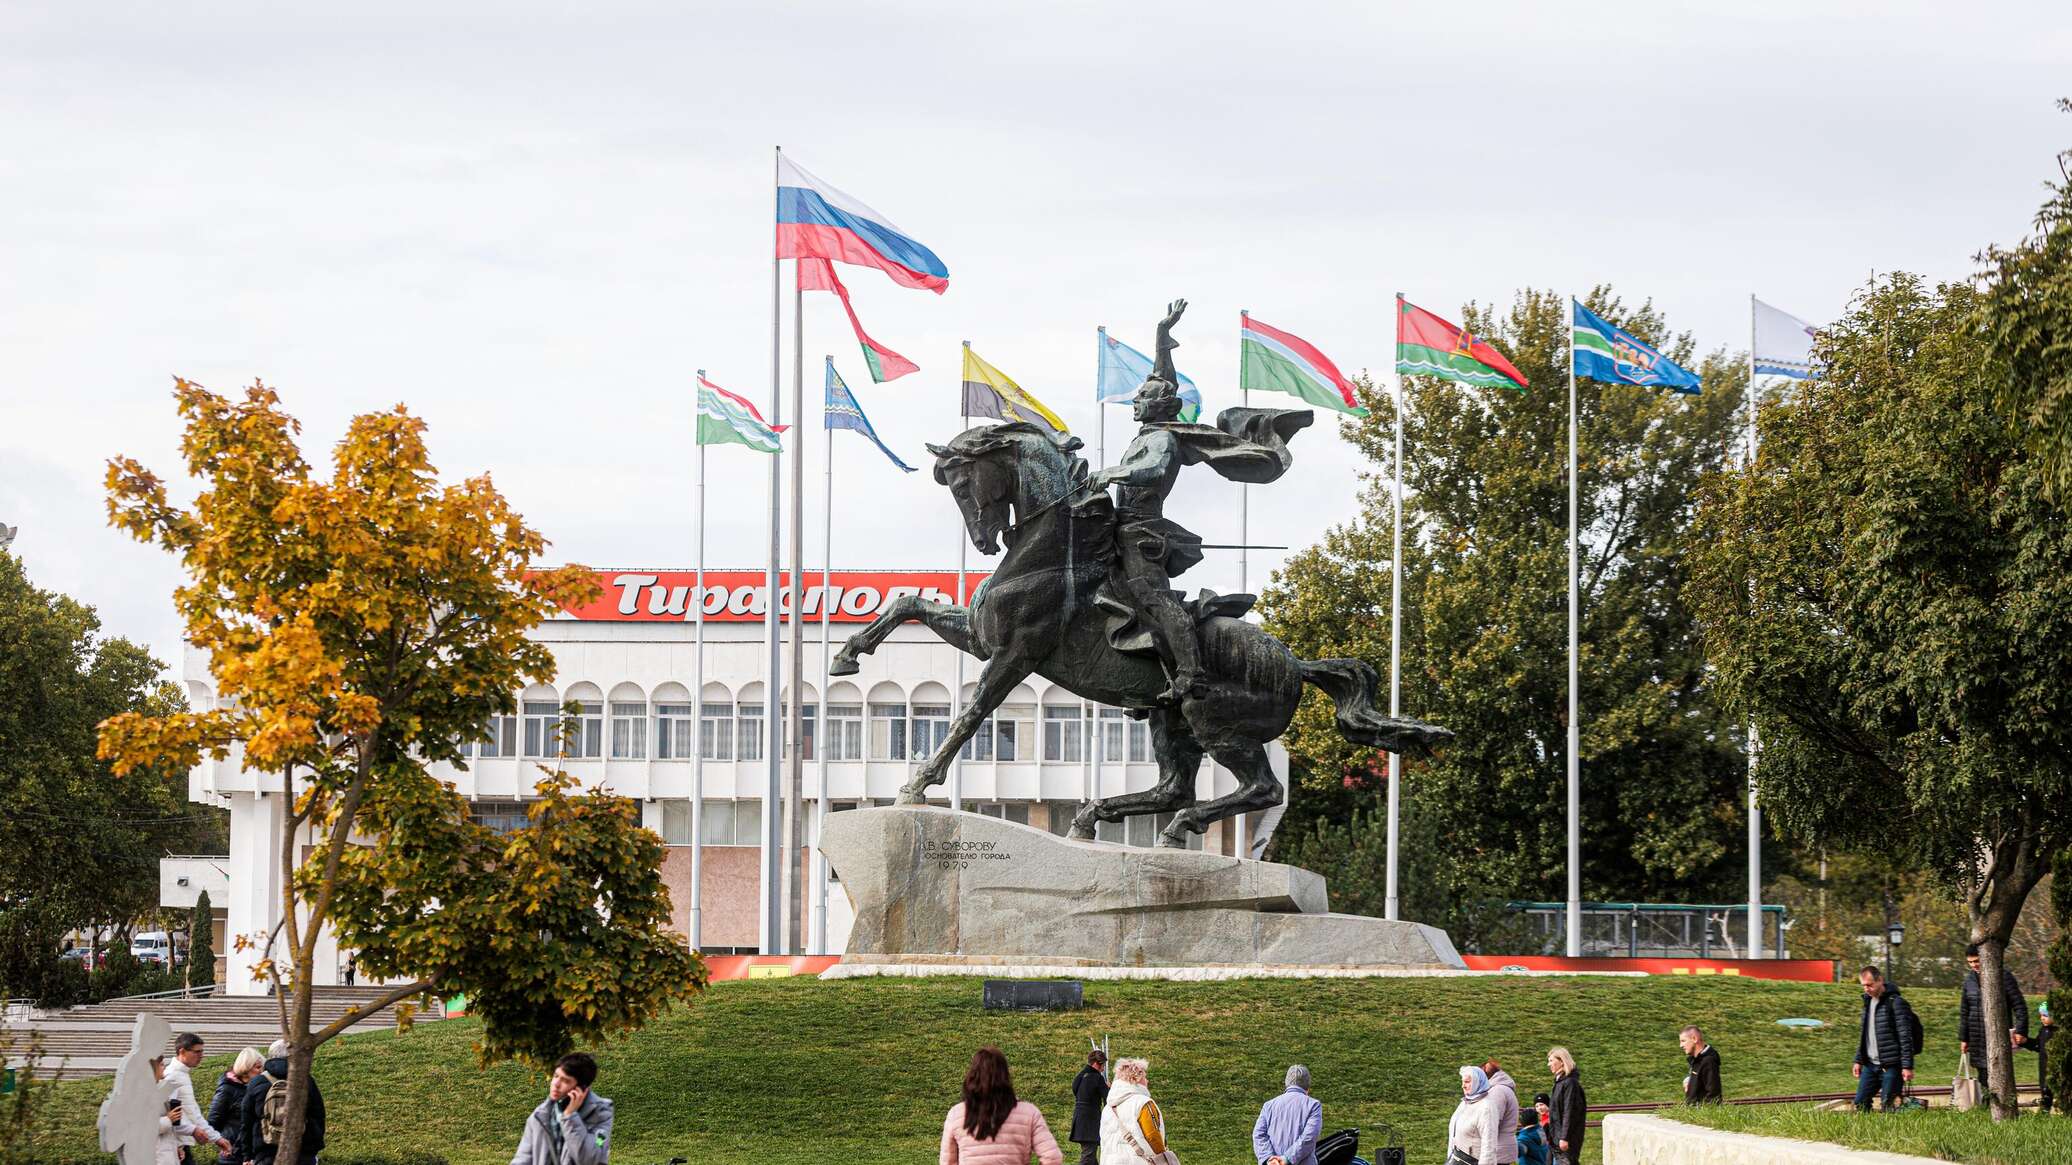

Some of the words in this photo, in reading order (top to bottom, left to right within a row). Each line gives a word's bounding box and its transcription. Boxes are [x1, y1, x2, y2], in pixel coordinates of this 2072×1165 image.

[942, 841, 997, 851] СУВОРОВУ
[925, 852, 977, 860] ОСНОВАТЕЛЮ
[938, 861, 969, 870] 1979
